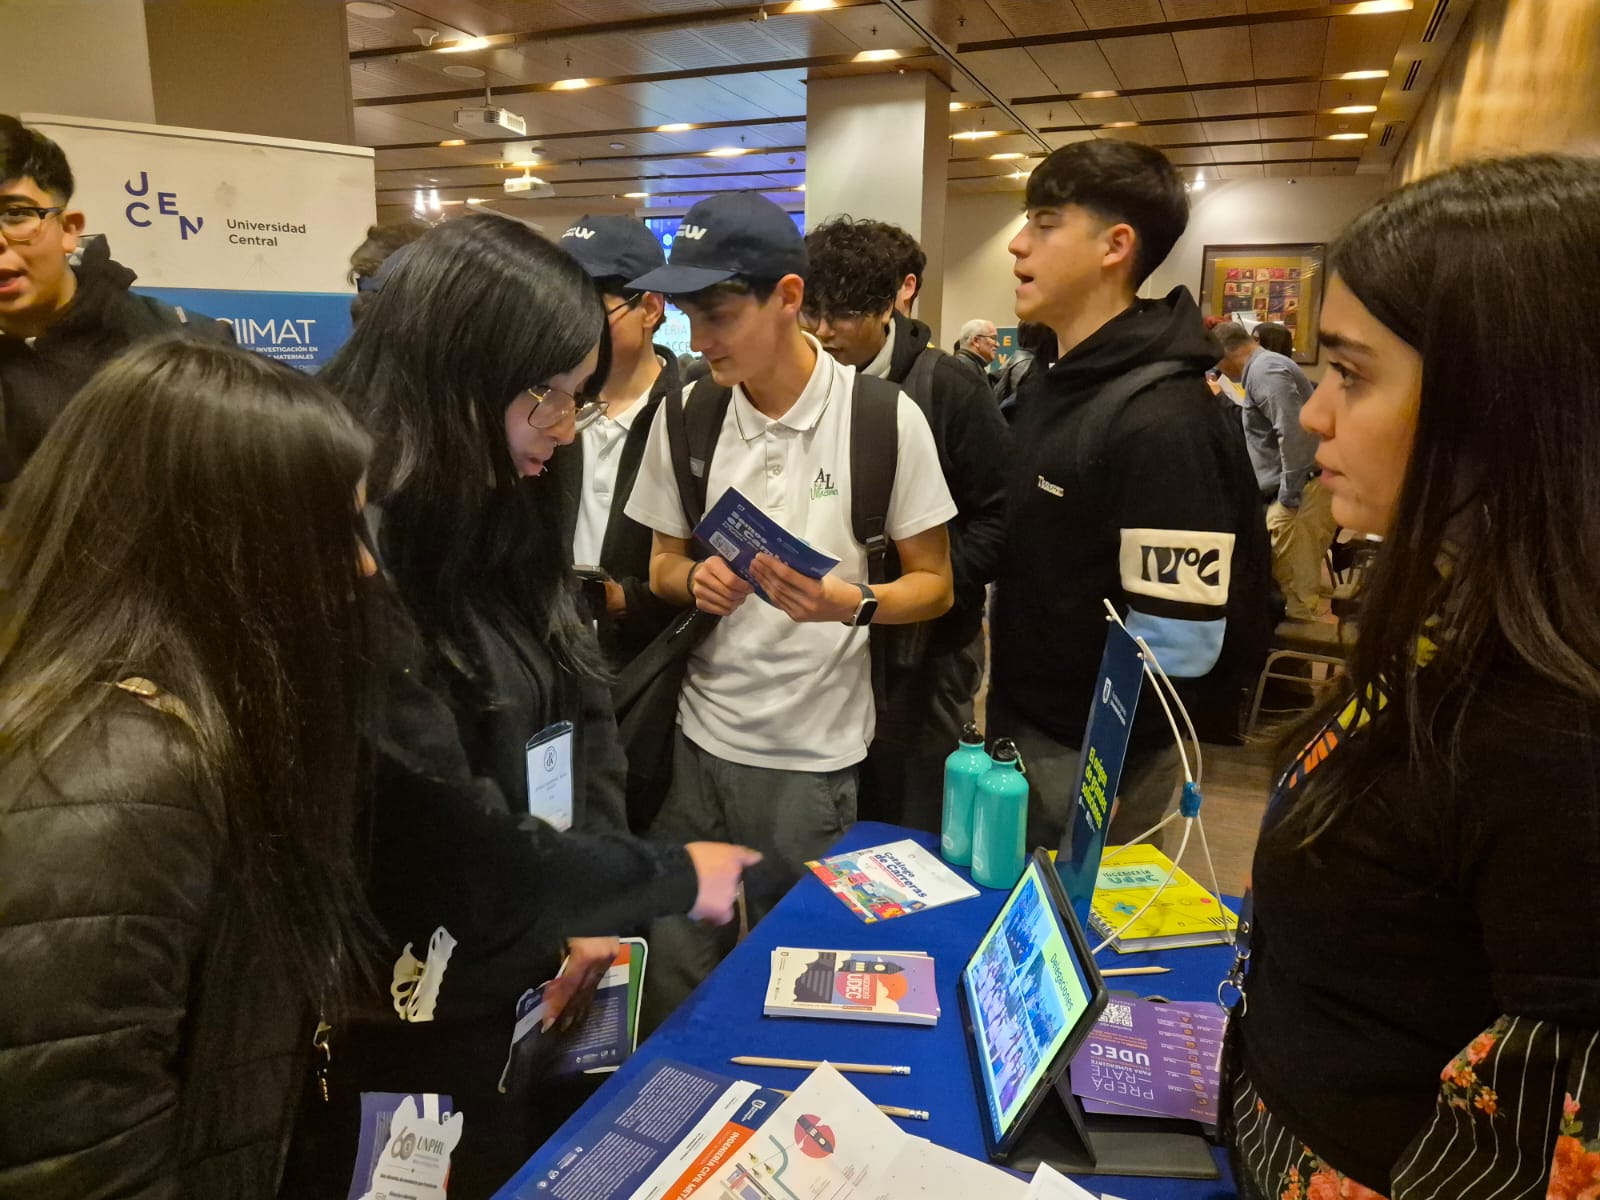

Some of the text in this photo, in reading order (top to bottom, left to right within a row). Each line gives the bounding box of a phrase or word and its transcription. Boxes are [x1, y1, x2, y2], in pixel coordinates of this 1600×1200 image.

[226, 218, 307, 234] Universidad
[229, 234, 278, 247] Central
[874, 854, 928, 898] de Carreras
[845, 973, 862, 1000] UDEC
[1050, 952, 1074, 1012] Delegaciones
[1089, 1043, 1150, 1067] UDEC
[705, 1131, 741, 1170] INGENIERÍA
[690, 1164, 711, 1186] CIVIL
